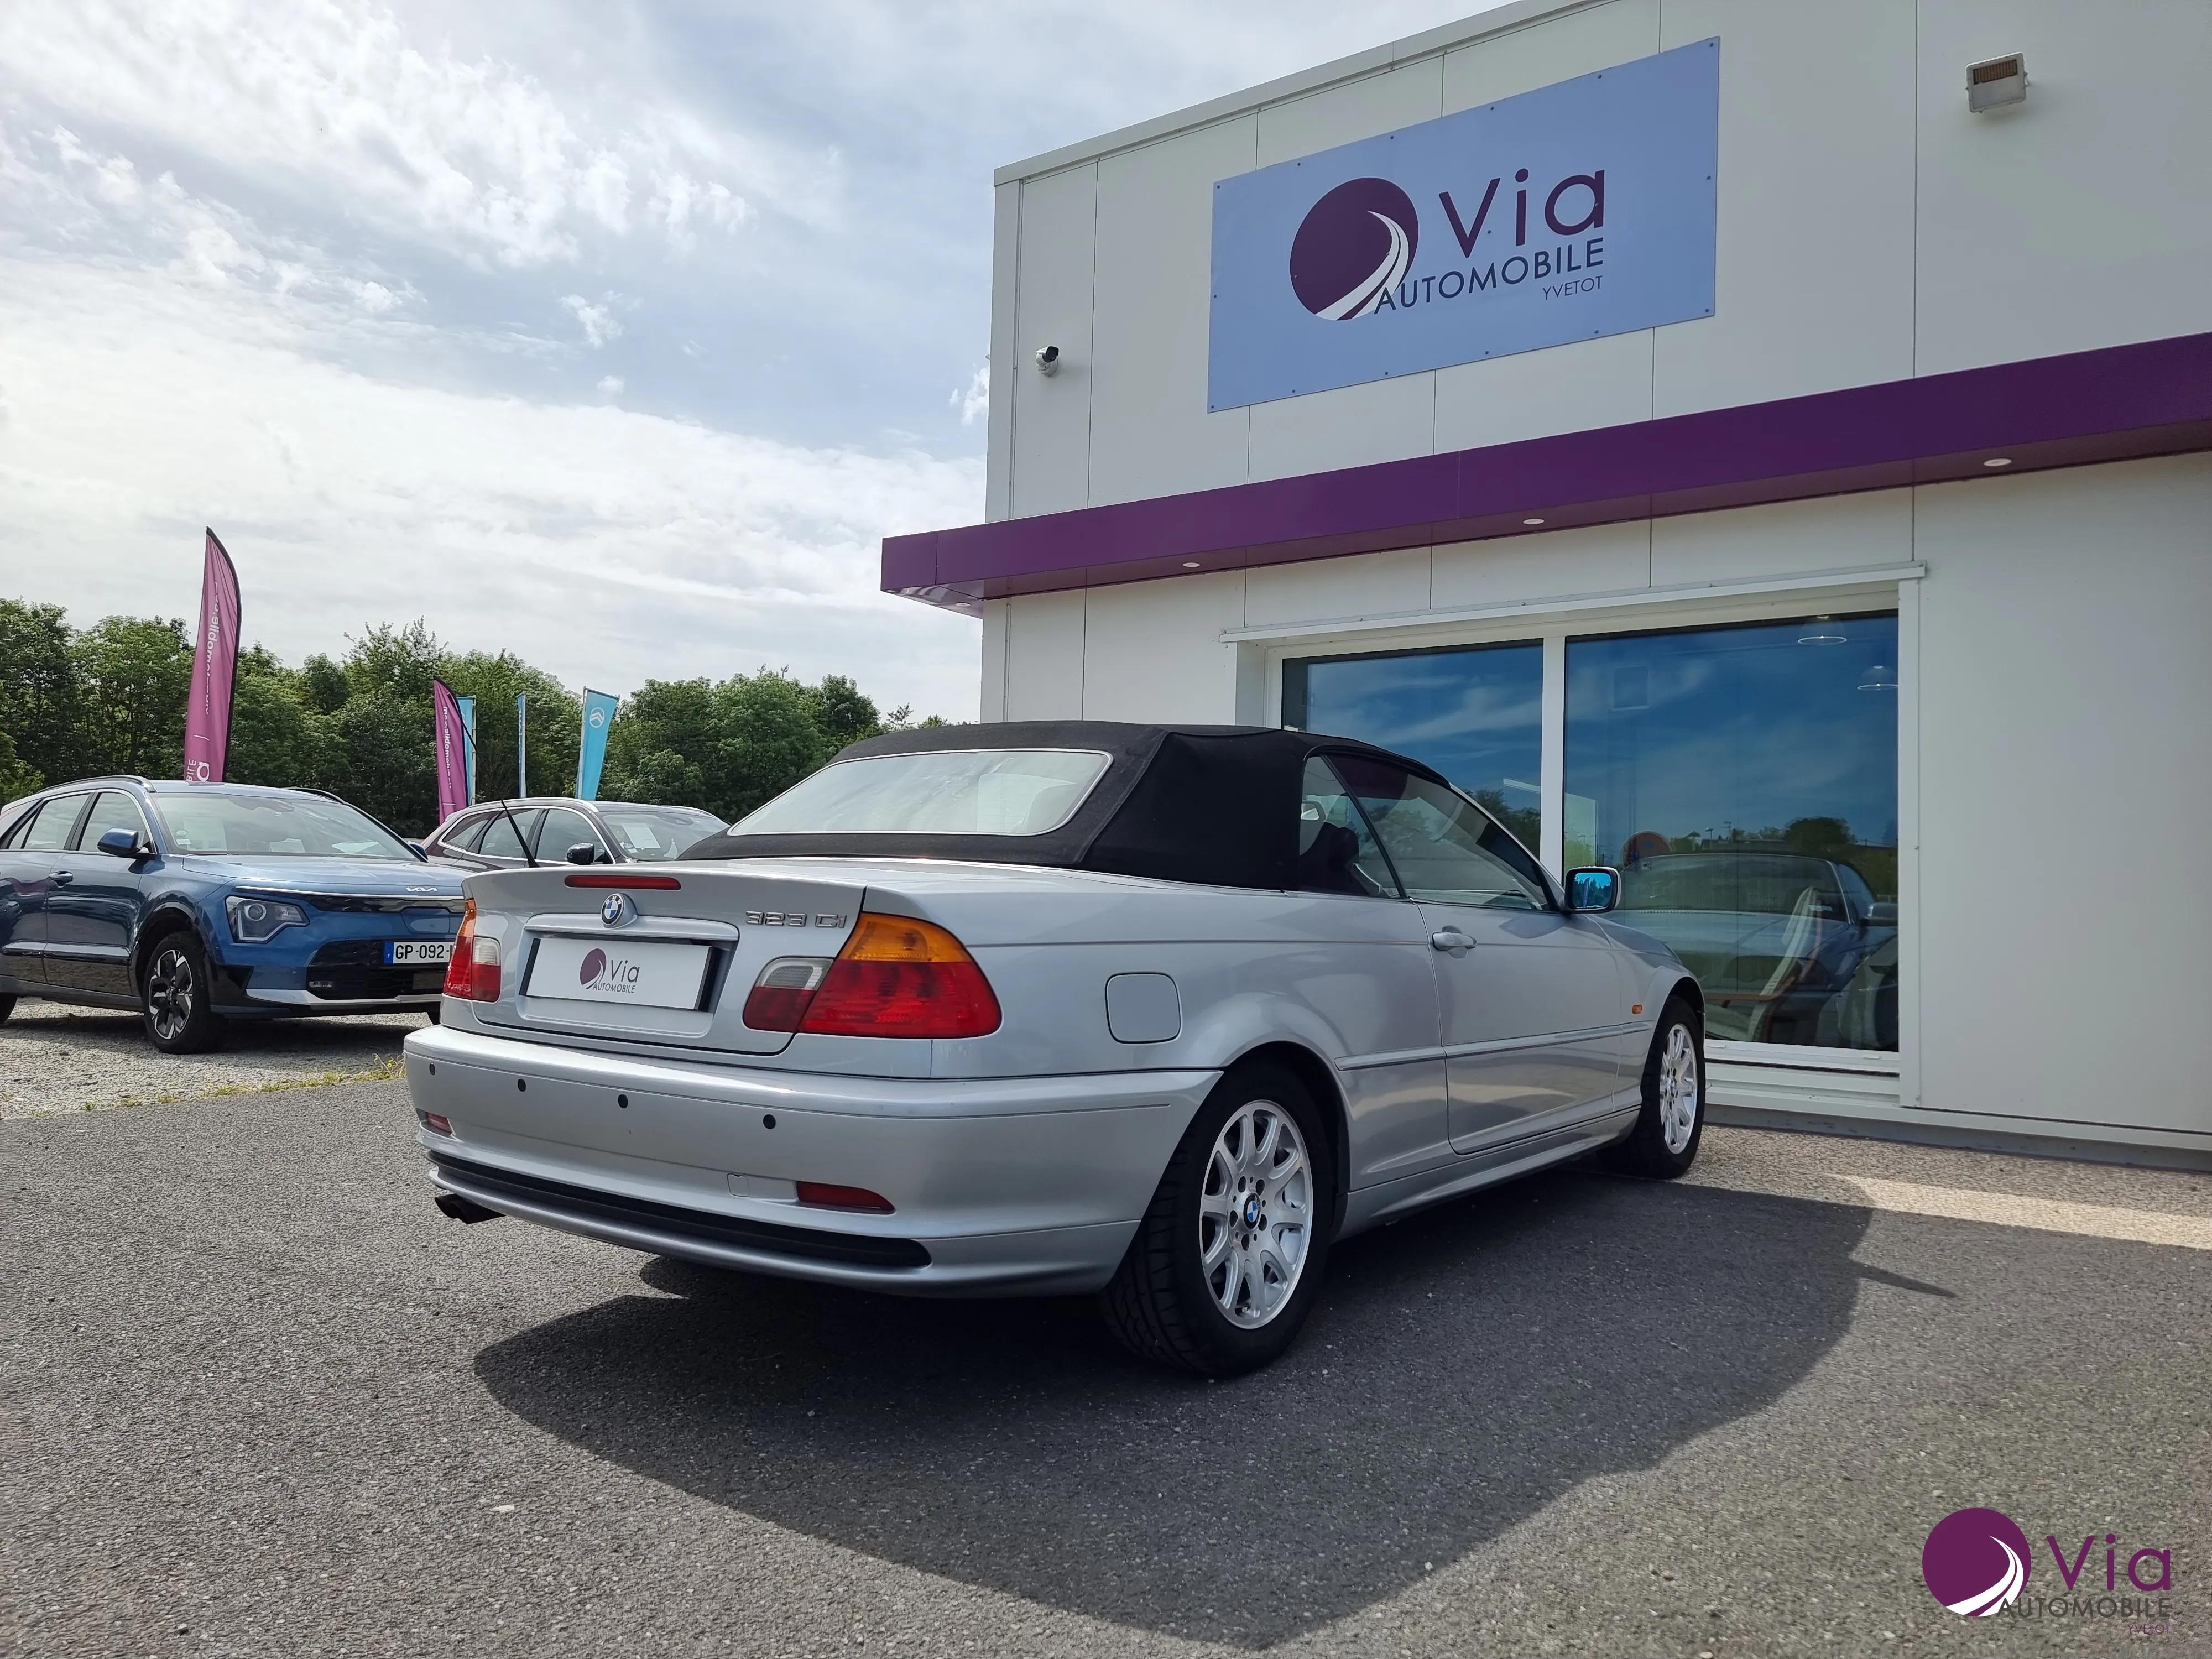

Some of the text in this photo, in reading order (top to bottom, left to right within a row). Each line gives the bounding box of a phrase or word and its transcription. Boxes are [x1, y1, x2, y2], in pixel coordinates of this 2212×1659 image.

[1438, 168, 1605, 258] Via
[1374, 237, 1604, 315] AUTOMOBILE
[1542, 275, 1603, 301] YVETOT
[746, 911, 847, 928] 323 Ci
[395, 944, 454, 959] GP-092-
[611, 959, 640, 983] Via
[592, 983, 635, 993] AUTOMOBILE
